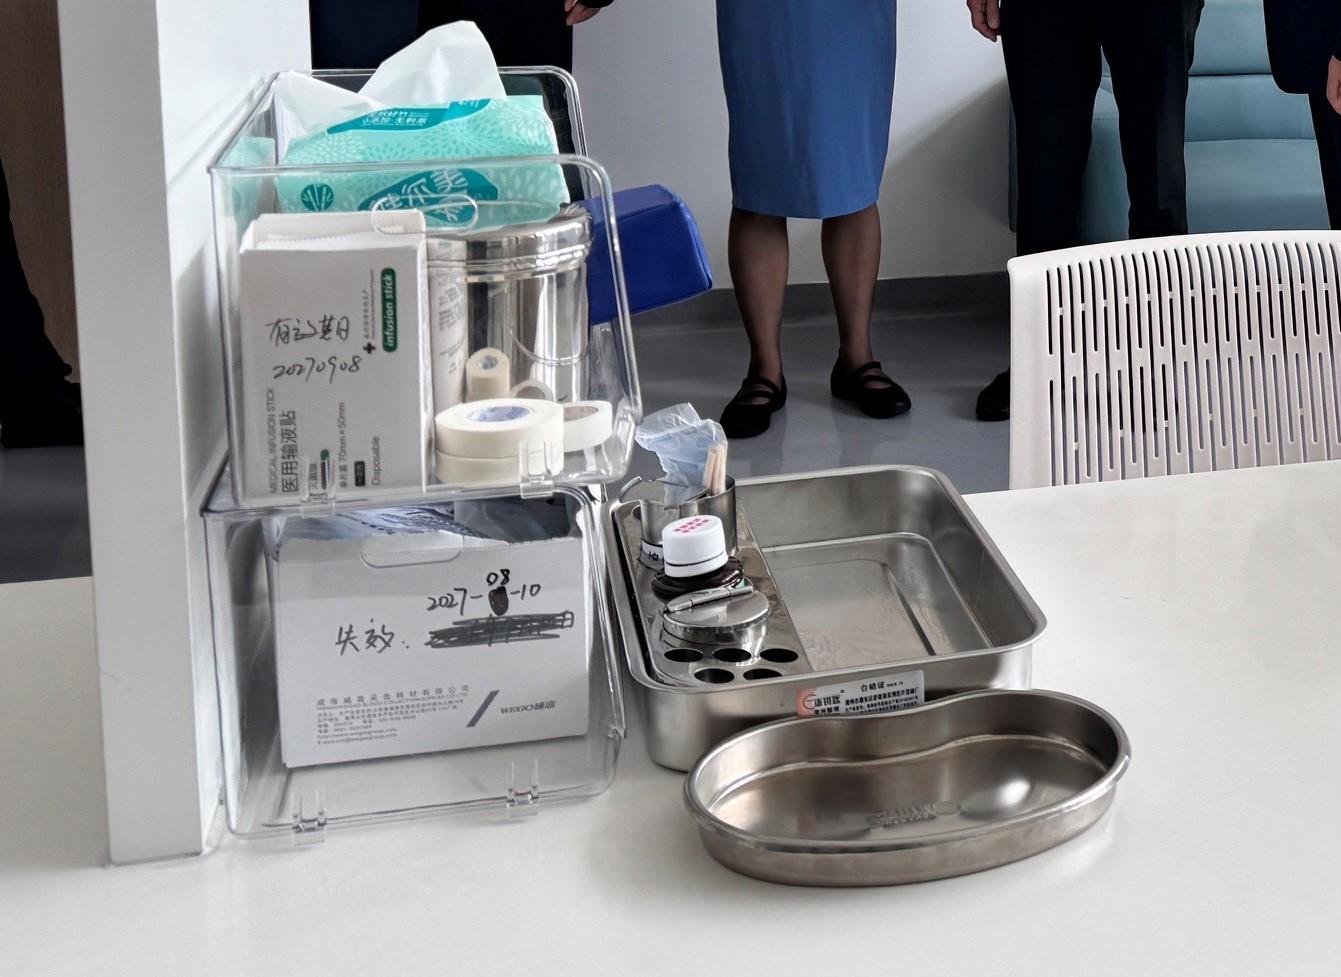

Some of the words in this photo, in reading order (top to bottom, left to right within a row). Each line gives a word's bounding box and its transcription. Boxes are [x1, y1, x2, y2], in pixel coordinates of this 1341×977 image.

[383, 274, 393, 299] stick
[384, 302, 394, 347] infusion
[265, 387, 276, 412] STICK
[267, 414, 277, 454] INFUSION
[279, 410, 299, 493] 医用输液贴
[268, 455, 278, 494] MEDICAL
[371, 435, 382, 486] Disposable
